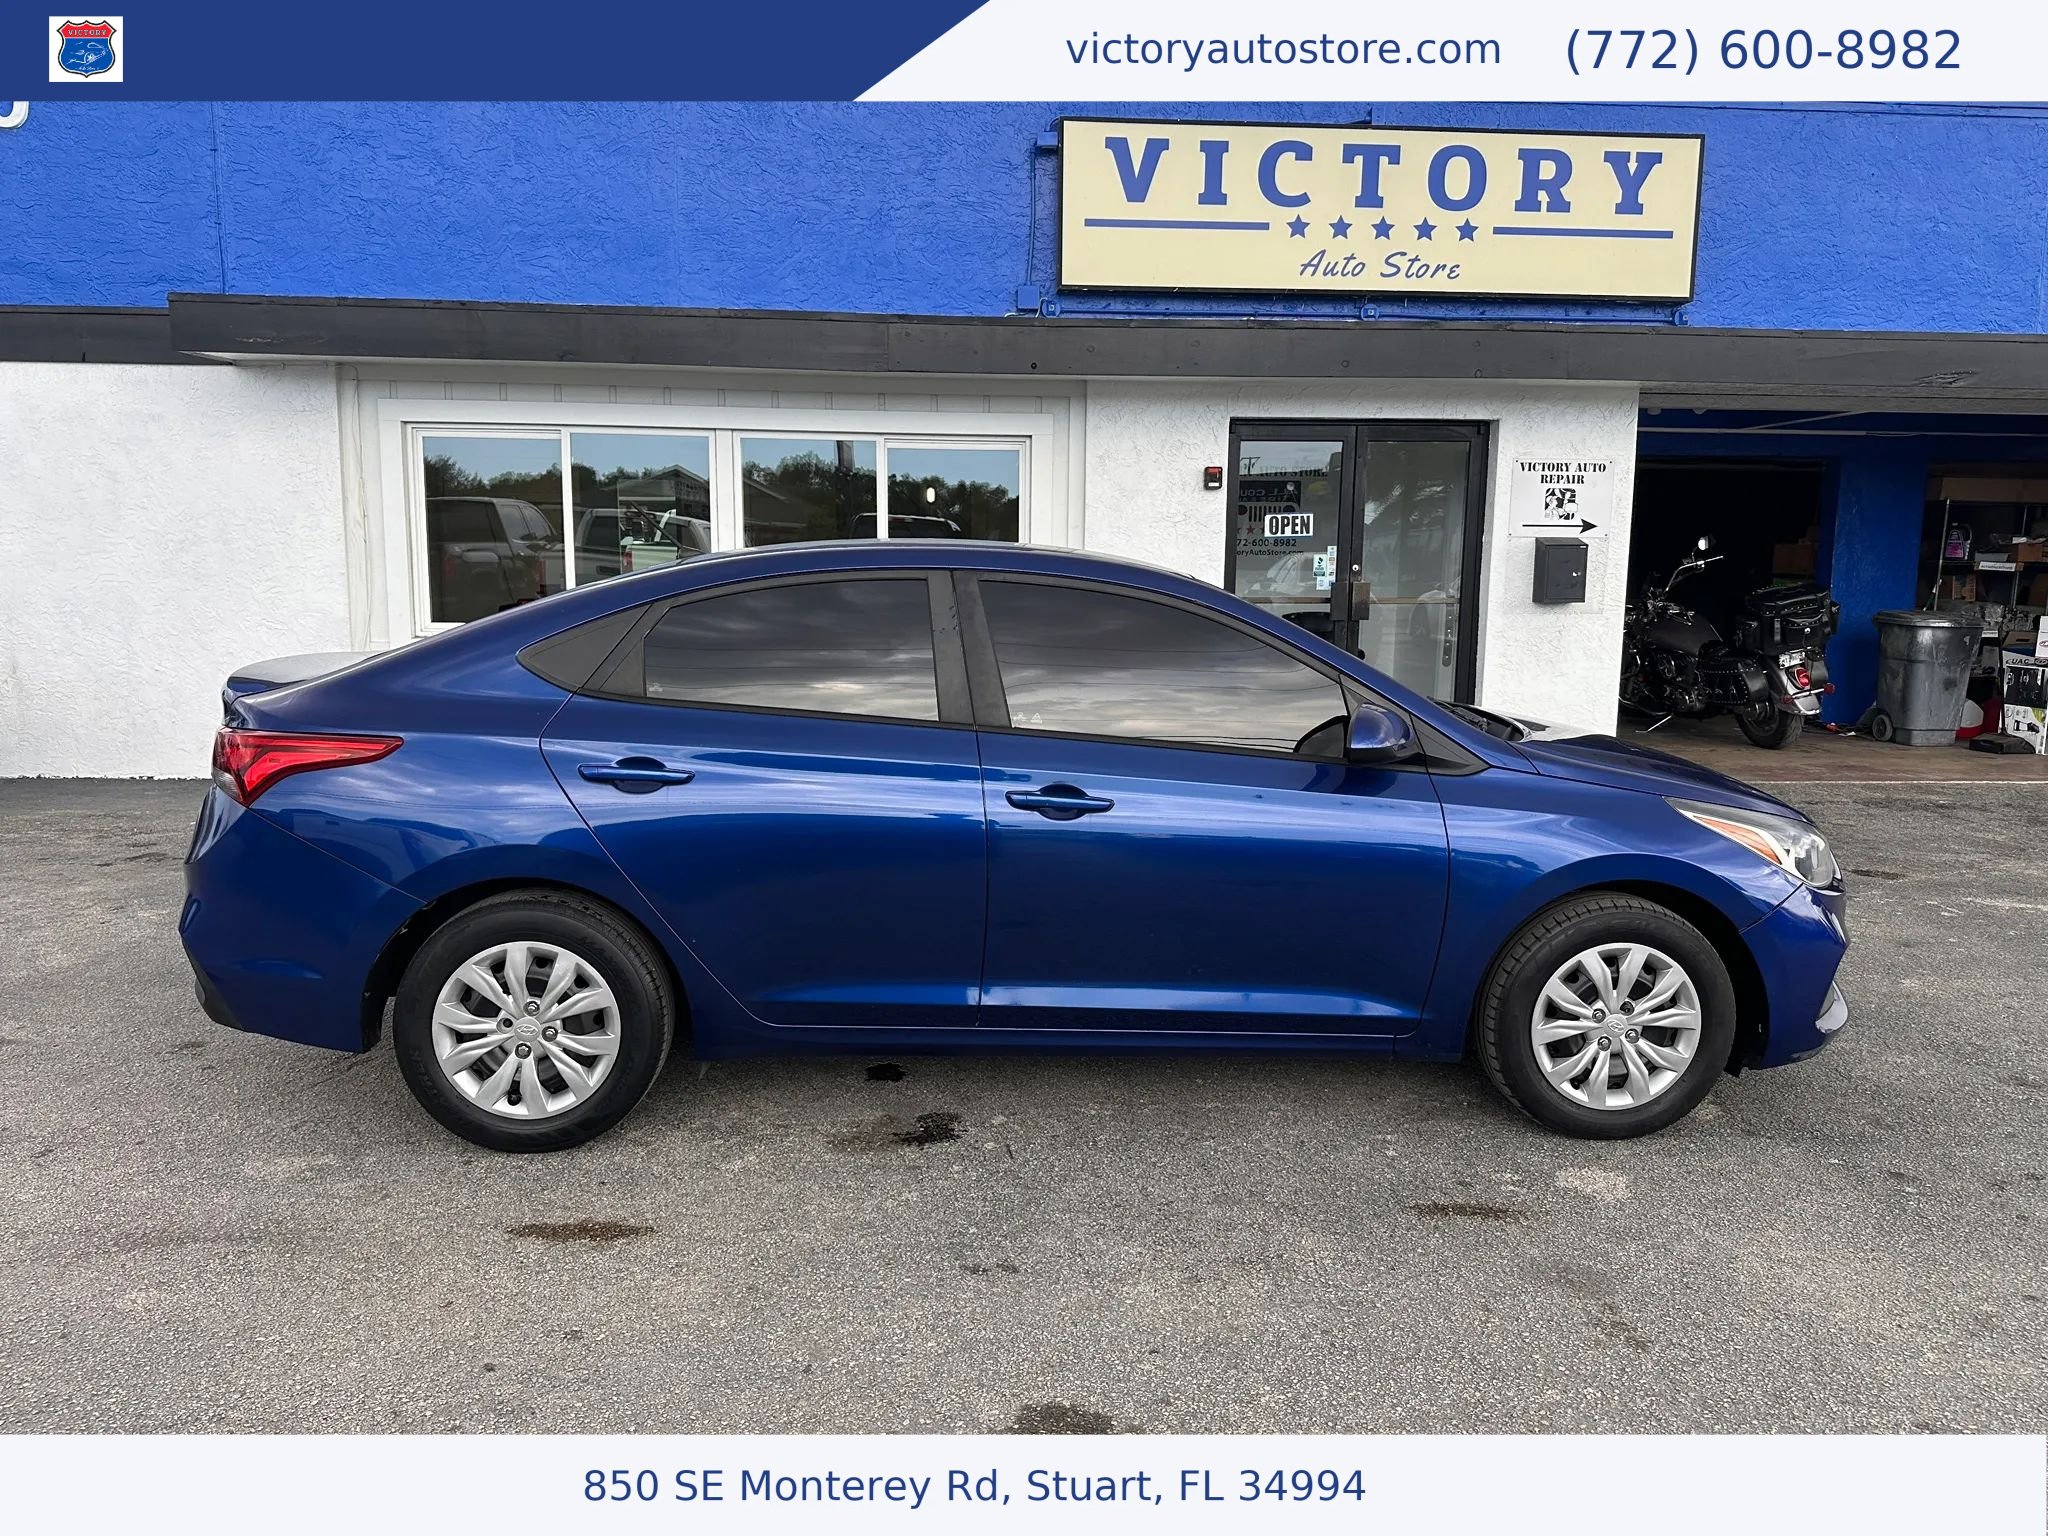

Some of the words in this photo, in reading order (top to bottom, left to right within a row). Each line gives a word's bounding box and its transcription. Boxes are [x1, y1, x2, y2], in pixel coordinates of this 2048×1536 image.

[1104, 136, 1663, 215] VICTORY
[1299, 248, 1366, 279] Auto
[1379, 250, 1461, 280] Store
[1519, 462, 1571, 472] VICTORY
[1574, 462, 1607, 473] AUTO
[1540, 474, 1585, 484] REPAIR
[1268, 515, 1311, 536] OPEN
